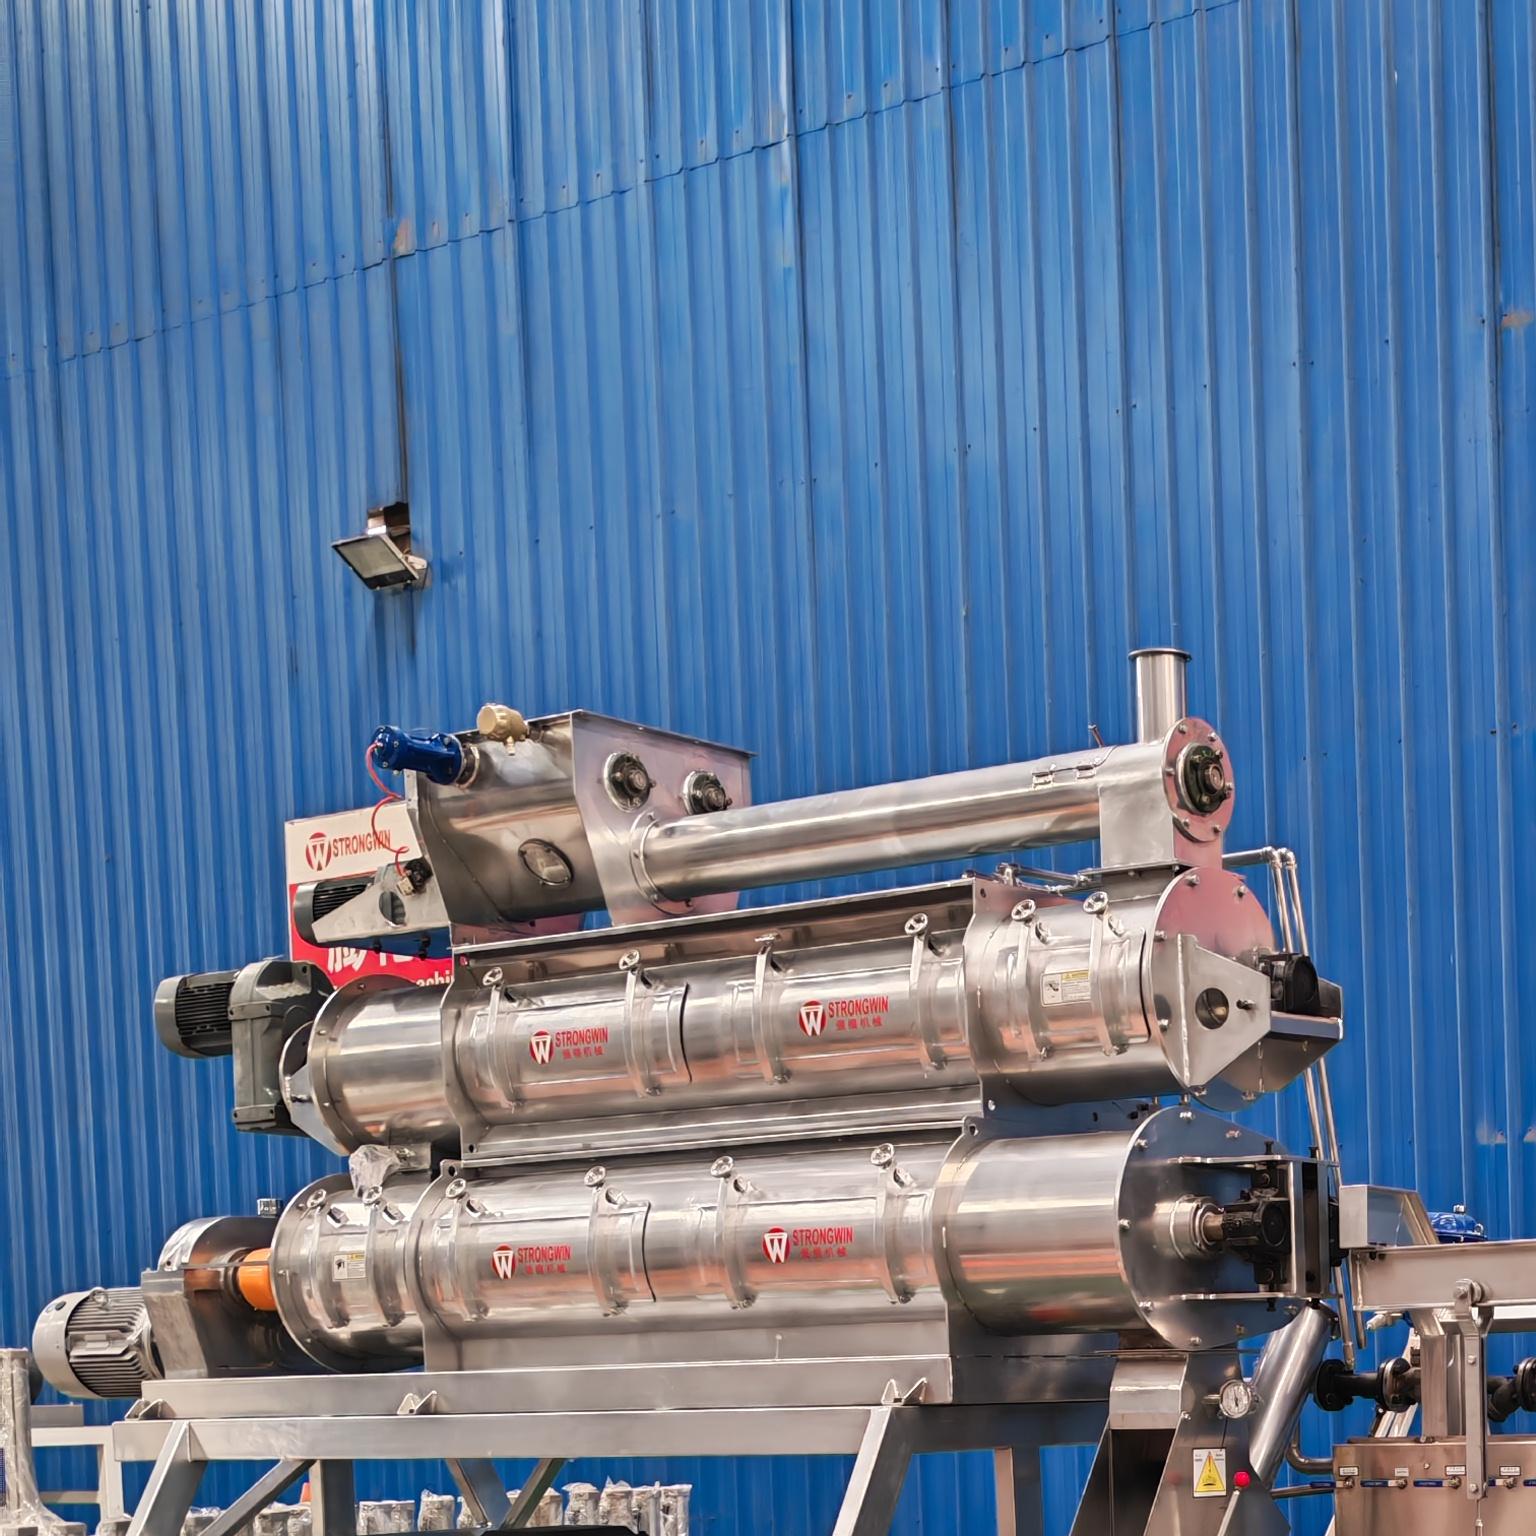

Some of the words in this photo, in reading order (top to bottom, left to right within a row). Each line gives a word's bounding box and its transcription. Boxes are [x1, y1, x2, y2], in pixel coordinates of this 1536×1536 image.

[828, 996, 889, 1018] STRONGWIN
[555, 1026, 609, 1048] STRONGWIN
[792, 1226, 853, 1246] STRONGWIN
[517, 1245, 572, 1264] STRONGWIN
